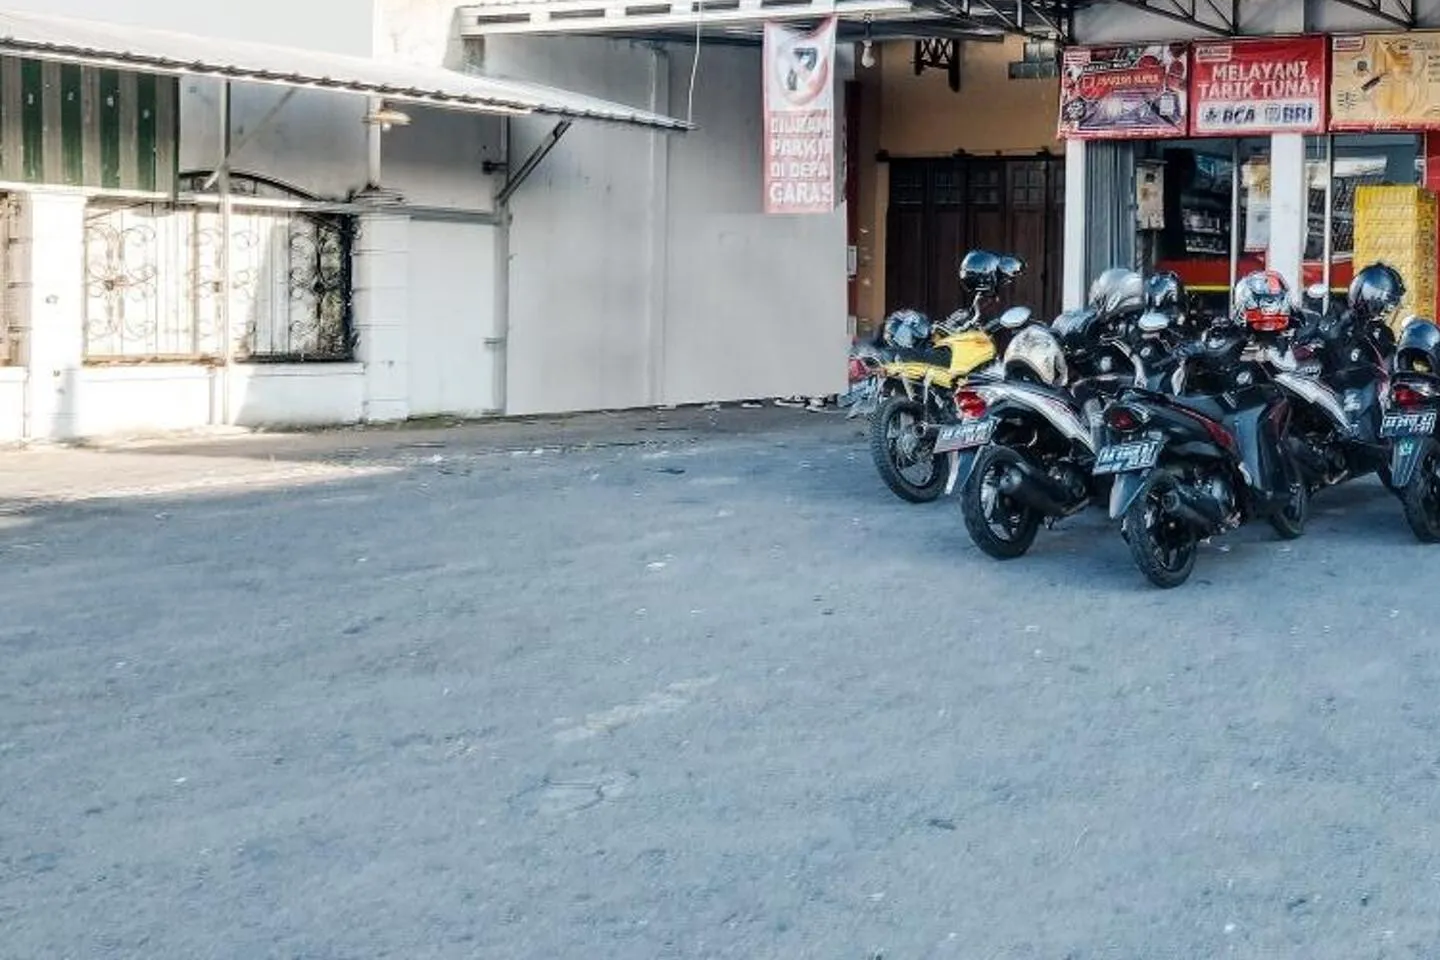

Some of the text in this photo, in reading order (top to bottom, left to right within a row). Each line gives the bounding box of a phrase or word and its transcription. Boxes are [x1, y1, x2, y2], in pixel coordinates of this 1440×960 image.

[1211, 61, 1309, 82] MELAYANI
[1197, 78, 1320, 101] TARIK TUNAI
[1222, 106, 1313, 124] BCA BRI
[770, 161, 785, 178] DI
